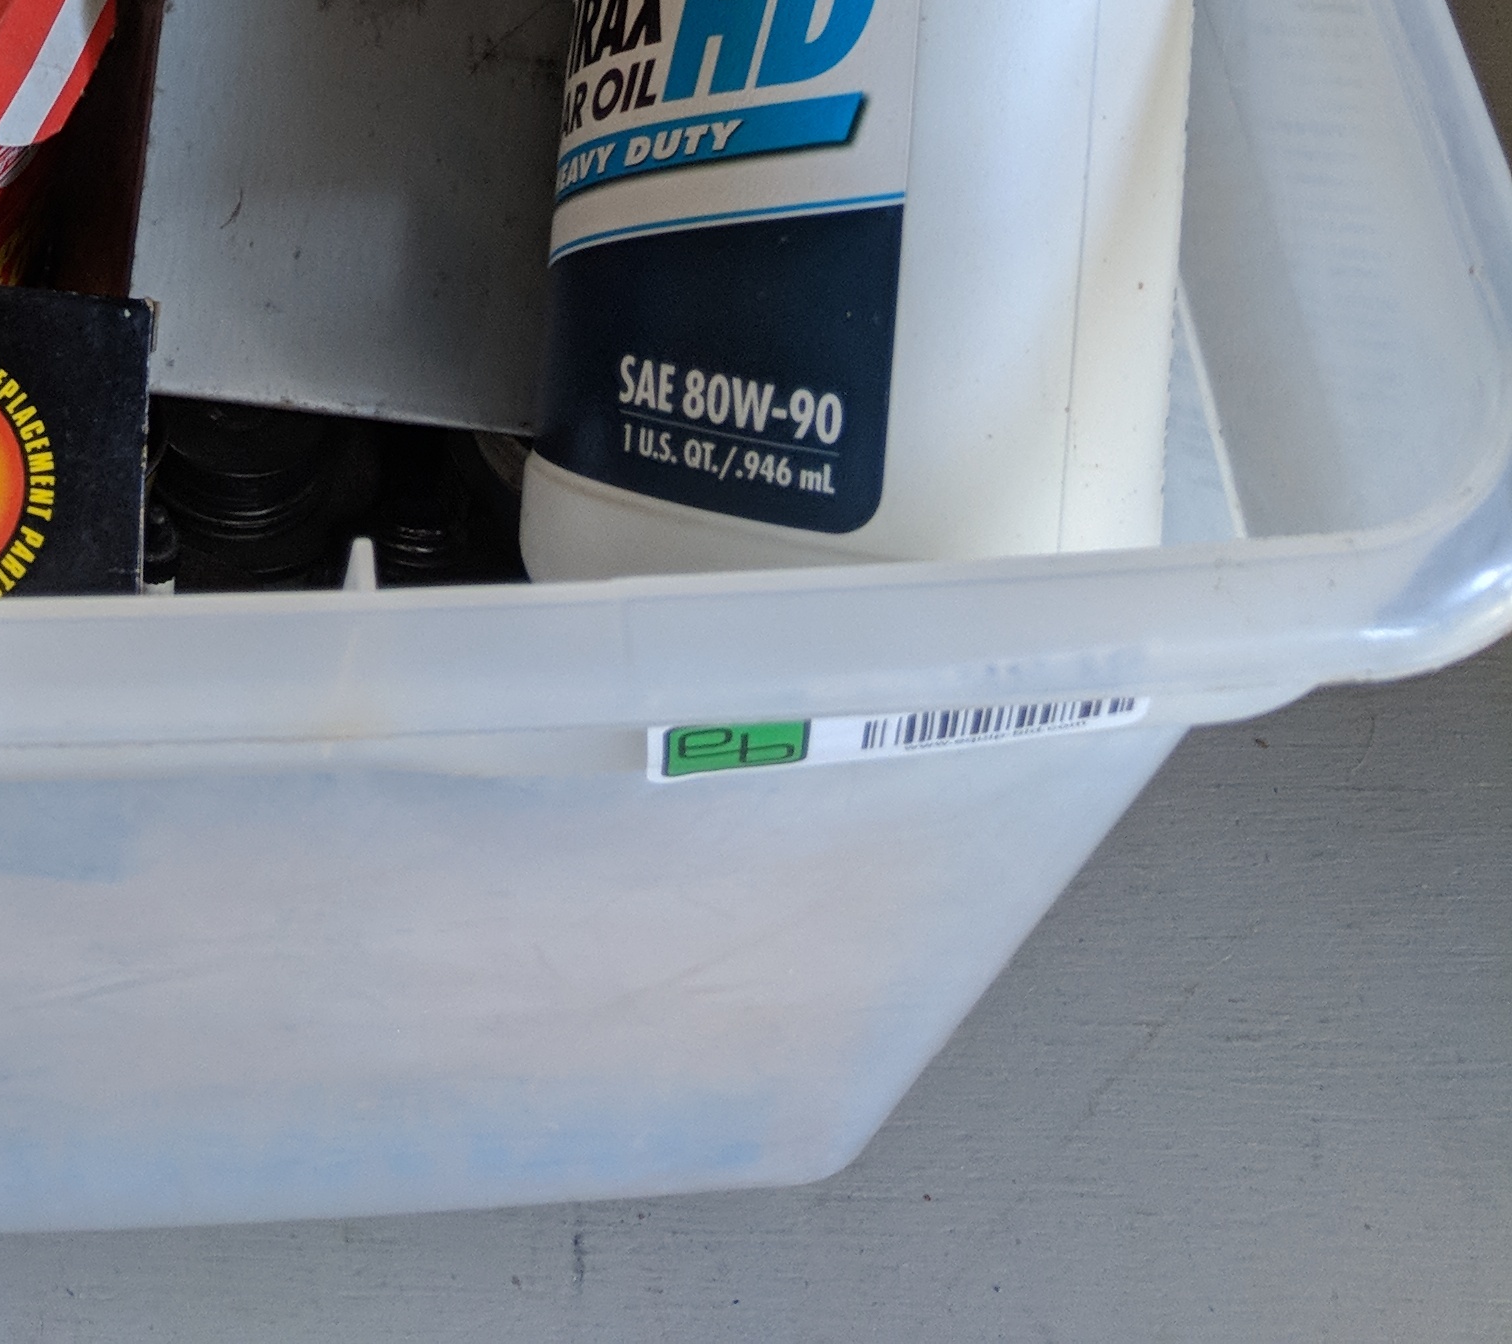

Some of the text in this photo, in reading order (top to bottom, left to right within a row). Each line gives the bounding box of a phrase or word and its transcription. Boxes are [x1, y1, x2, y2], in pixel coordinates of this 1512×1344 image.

[592, 58, 657, 122] OIL
[623, 117, 745, 167] DUTY
[618, 354, 843, 445] SAE 80W-90
[623, 422, 632, 453] 1
[638, 426, 678, 464] U.S.
[799, 463, 836, 495] mL
